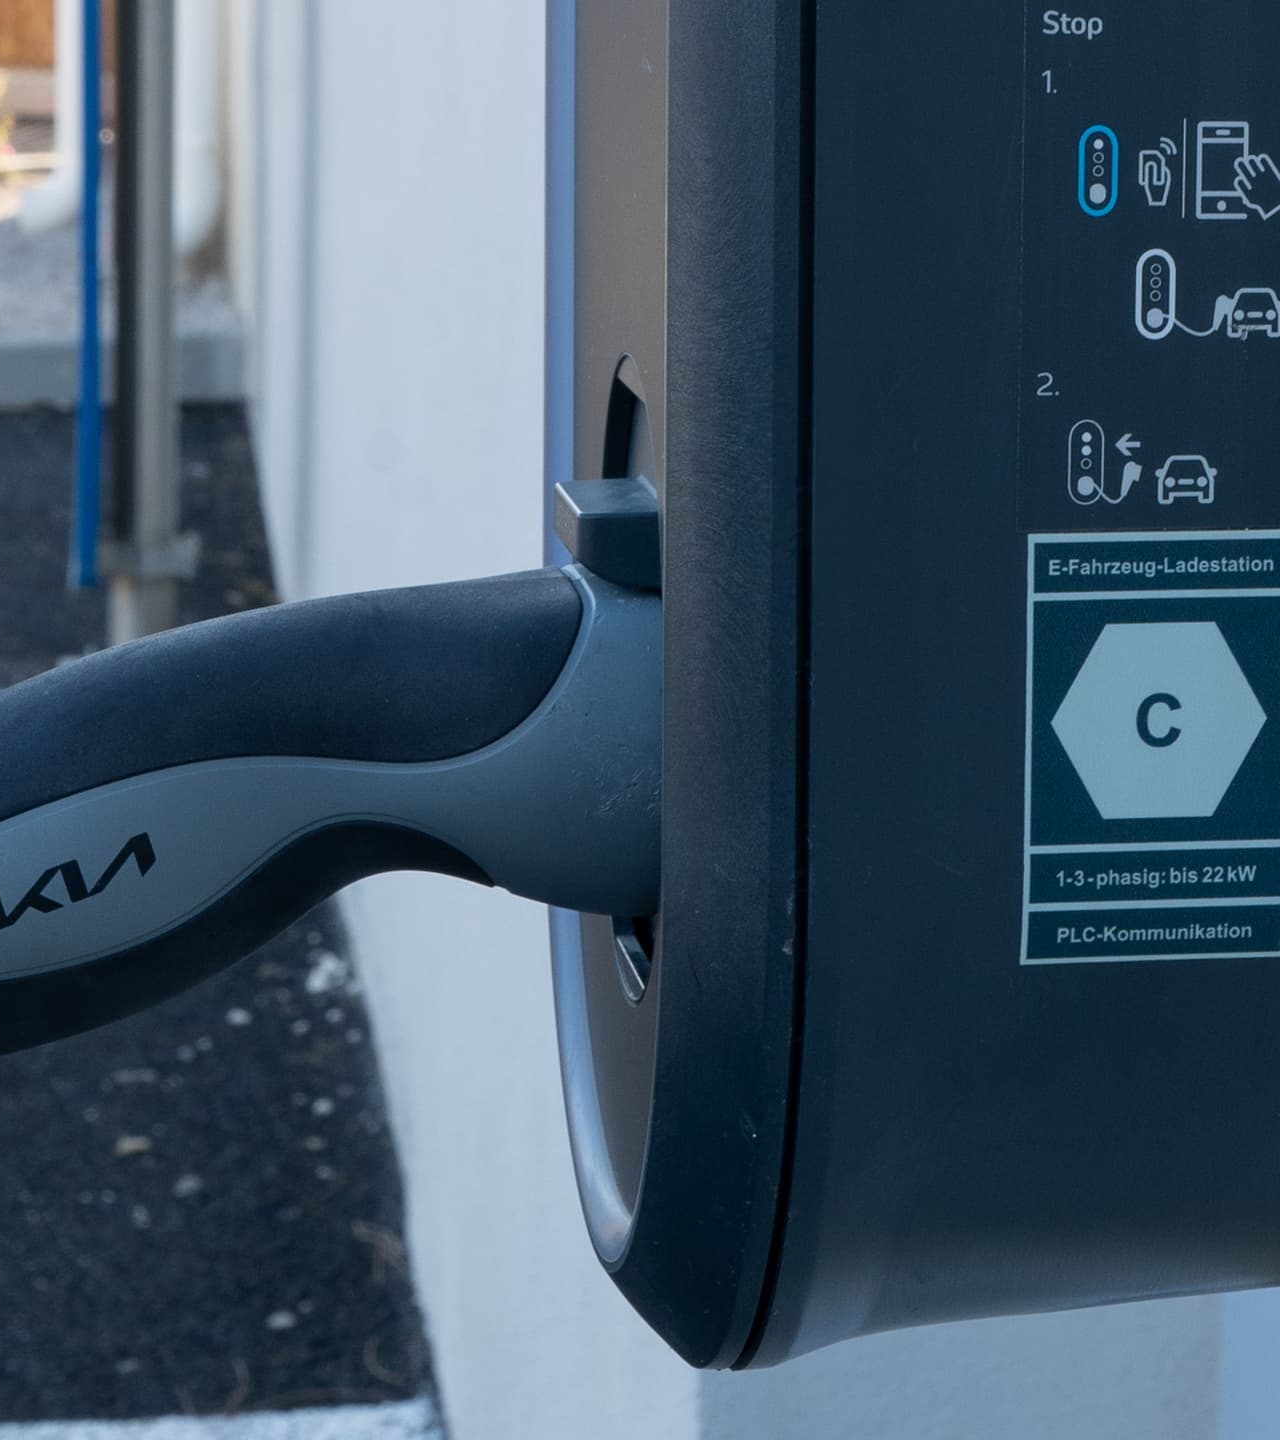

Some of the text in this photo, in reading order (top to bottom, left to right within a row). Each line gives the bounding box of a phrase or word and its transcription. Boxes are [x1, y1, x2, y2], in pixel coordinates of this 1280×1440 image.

[1043, 11, 1102, 39] Stop
[1042, 70, 1056, 93] 1.
[1037, 372, 1059, 396] 2.
[1049, 556, 1273, 577] E-Fahrzeug-Ladestation
[1136, 693, 1181, 747] C
[1170, 867, 1198, 883] bis
[1202, 866, 1223, 883] 22
[1228, 866, 1256, 882] kW
[1057, 923, 1251, 943] PLC-Kommunikation
